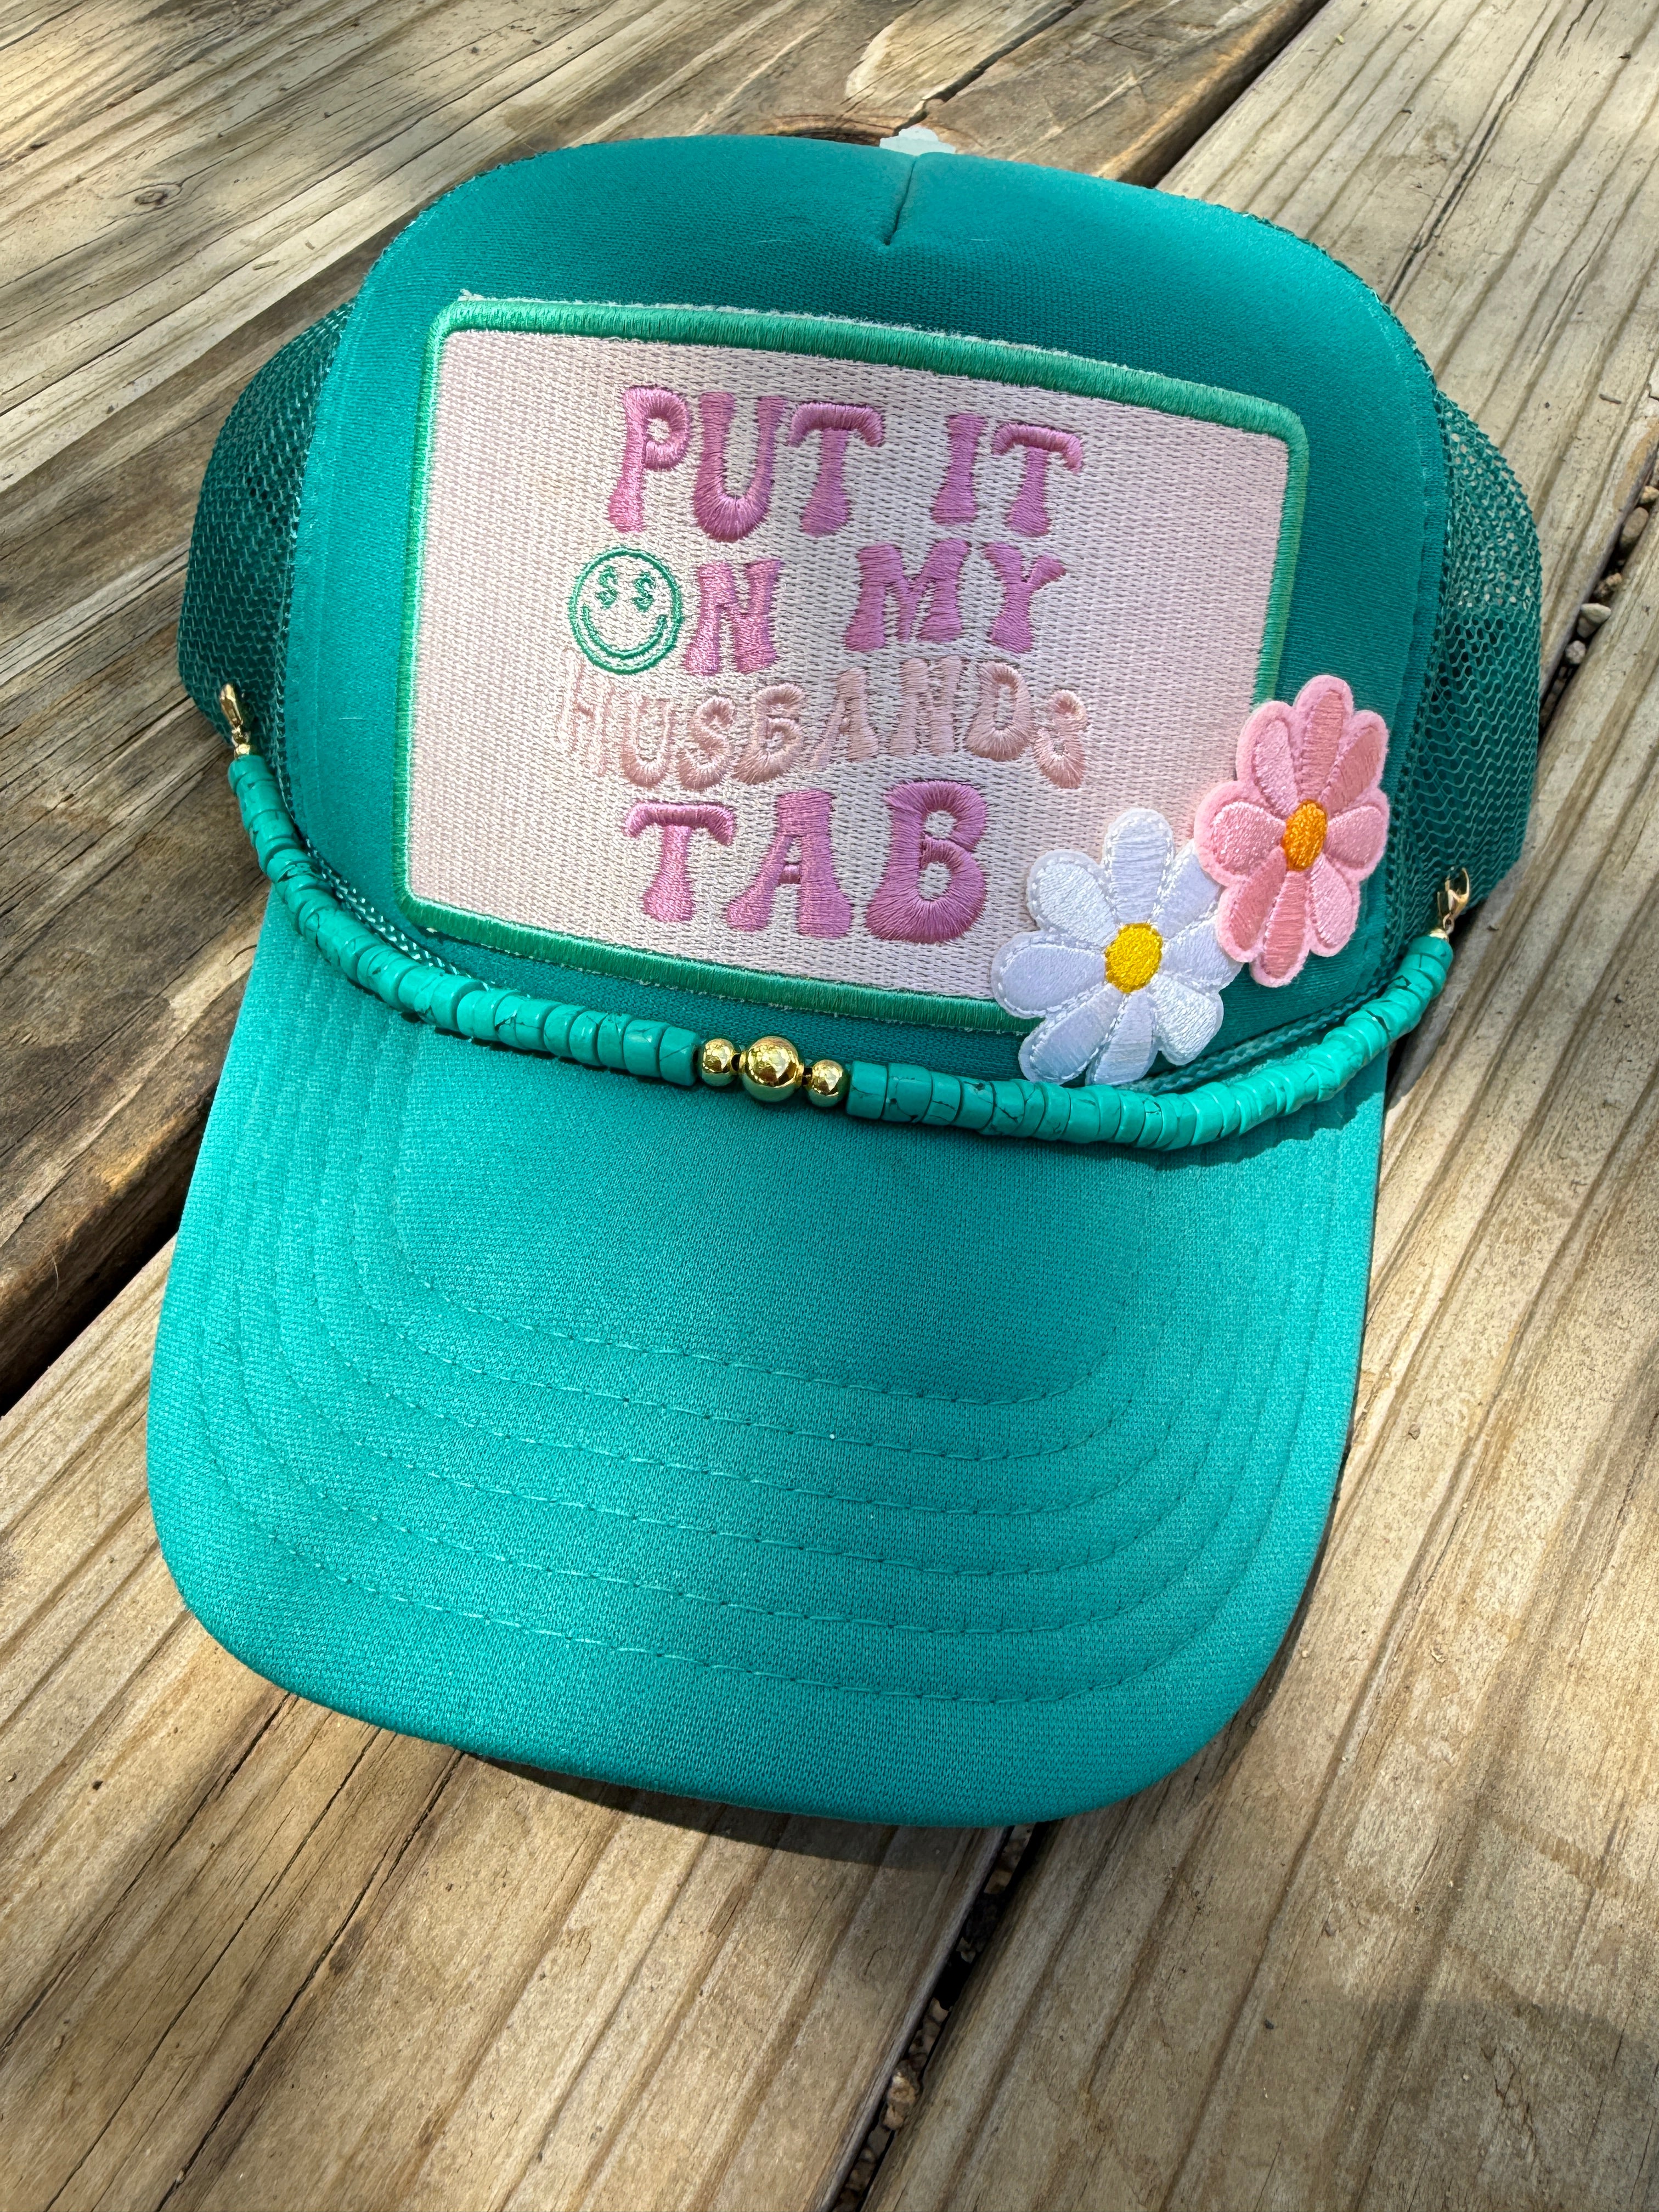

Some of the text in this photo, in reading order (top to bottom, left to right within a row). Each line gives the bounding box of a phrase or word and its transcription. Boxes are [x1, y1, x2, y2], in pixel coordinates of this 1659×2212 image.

[608, 385, 1084, 543] PUT IT
[843, 538, 1068, 653] MY
[623, 779, 989, 945] TAB
